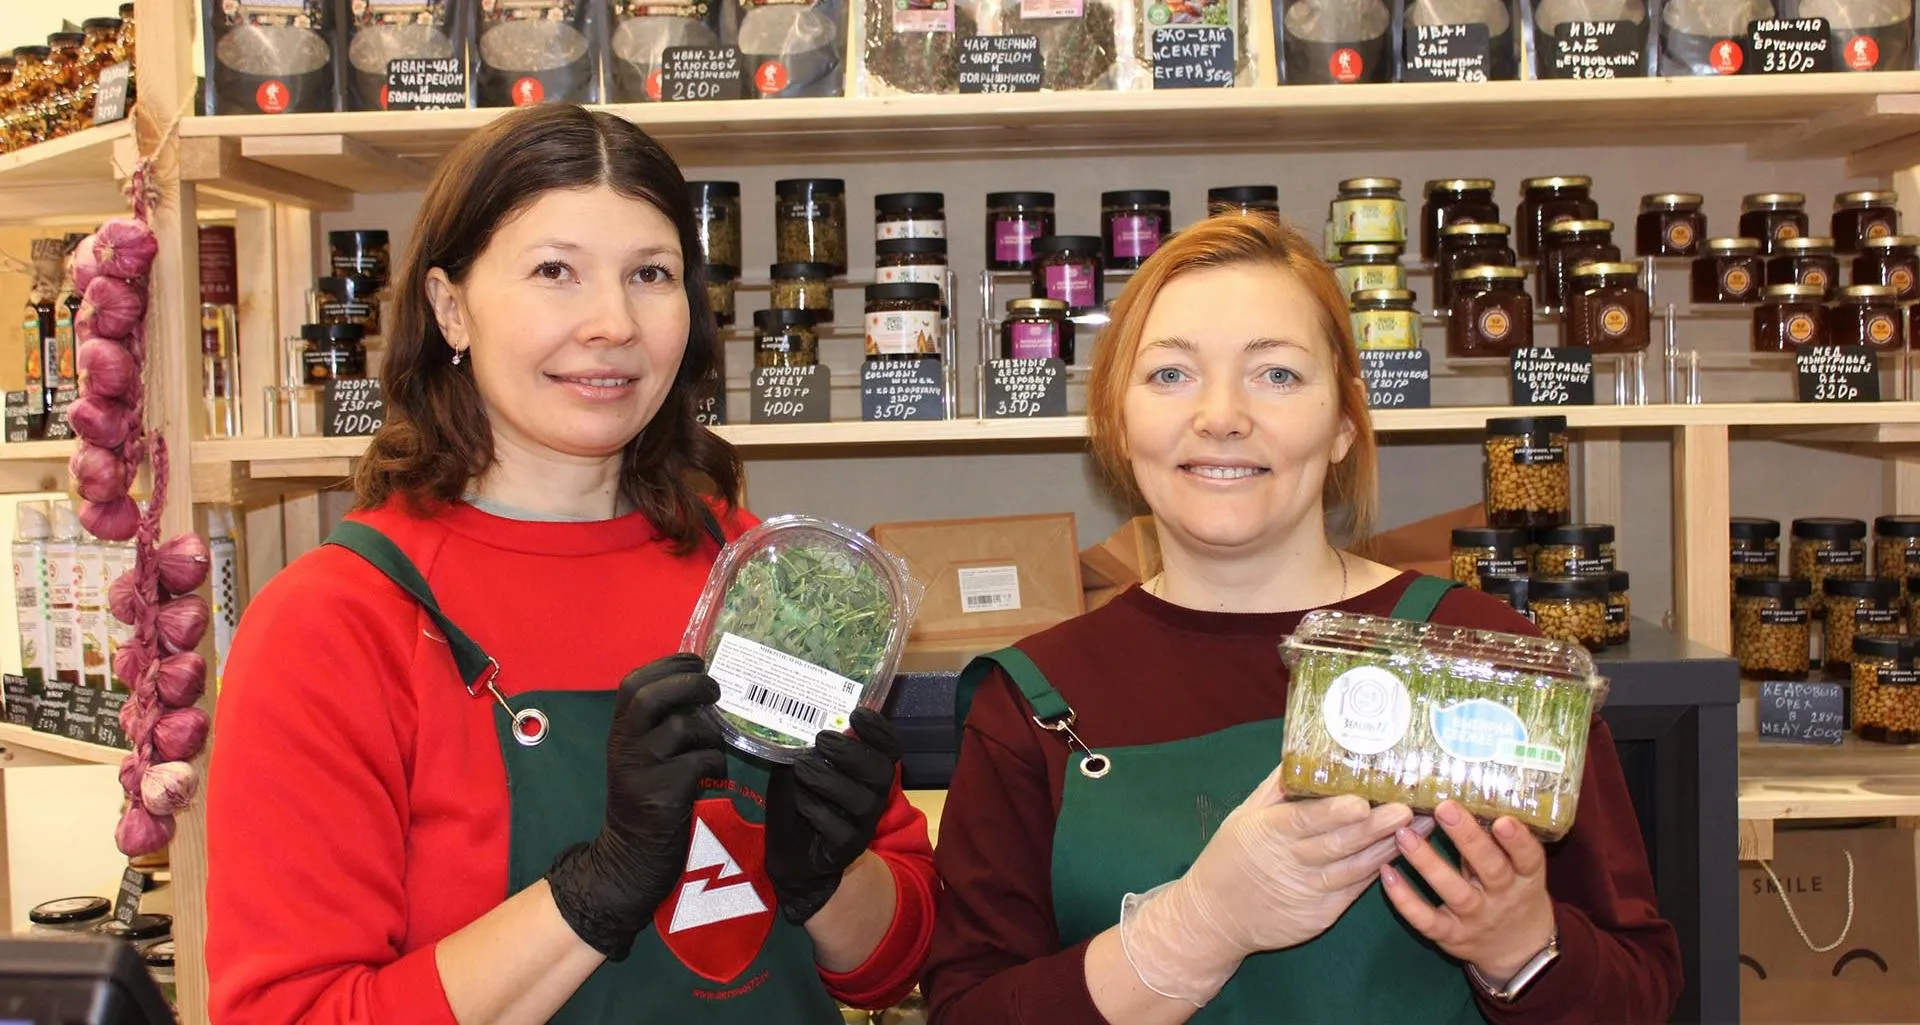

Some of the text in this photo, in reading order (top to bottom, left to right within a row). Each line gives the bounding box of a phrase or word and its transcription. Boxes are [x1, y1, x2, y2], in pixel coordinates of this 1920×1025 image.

[1570, 21, 1616, 38] ИВАН
[1757, 19, 1821, 32] ИВАН-ЧАЙ
[963, 36, 1038, 51] ЧАЙ ЧЕРНЫЙ
[1754, 38, 1827, 51] БРУСНИКОЙ
[674, 58, 737, 71] КЛЮКВОЙ
[970, 51, 1032, 65] ЧАБРЕЦОМ
[391, 58, 459, 74] ИВАН-ЧАЙ
[401, 73, 464, 87] ЧАБРЕЦОМ
[959, 72, 1041, 84] БОЯРЫШНИКОМ
[388, 91, 466, 104] БОЯРЫШНИКОМ
[1517, 347, 1556, 360] МЕД
[1812, 345, 1842, 358] МЕД
[871, 360, 920, 371] ВАРЕНЬЕ
[990, 357, 1047, 369] ТАЕЖНЫЙ
[1796, 355, 1867, 366] РАЗНОТРАВЬЕ
[762, 365, 816, 377] КОНОПЛЯ
[998, 366, 1042, 378] ДЕСЕРТ
[1513, 360, 1593, 375] РАЗНОТРАВЬЕ
[1800, 362, 1872, 374] ЦВЕТОЧНЫЙ
[769, 376, 804, 387] МЕДУ
[994, 375, 1052, 386] КЕДРОВЫХ
[1517, 371, 1590, 384] ЦВЕТОЧНЫЙ
[1004, 383, 1046, 393] ОРЕХОВ
[334, 389, 370, 401] МЕДУ
[1763, 682, 1839, 697] КЕДРОВЫЙ
[1775, 696, 1812, 711] ОРЕХ
[1761, 721, 1801, 735] МЕДУ
[1752, 875, 1824, 896] SMILE
